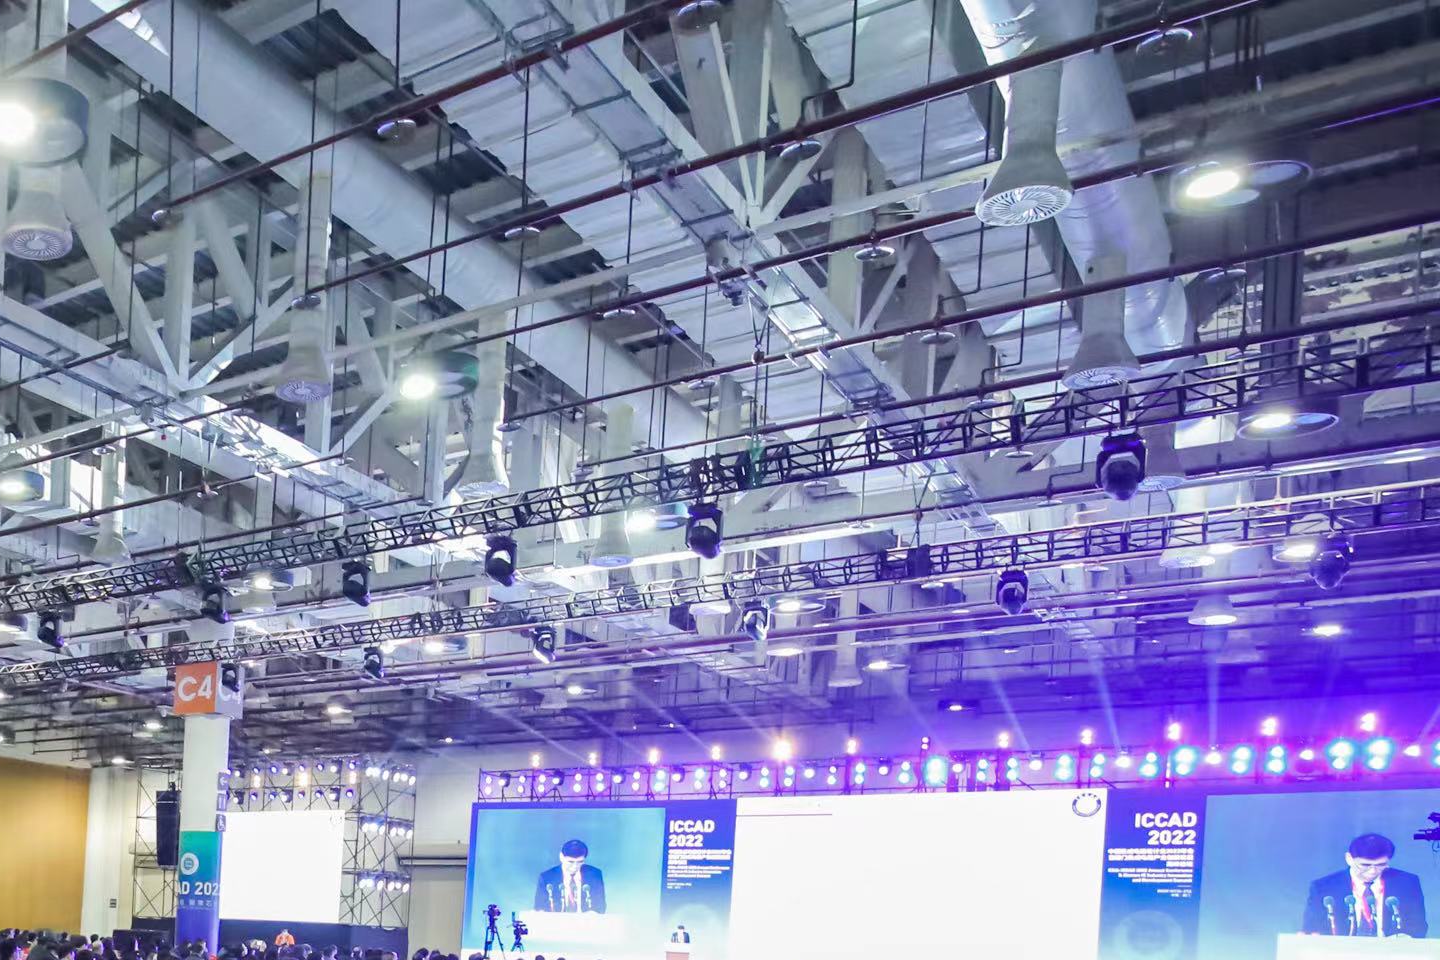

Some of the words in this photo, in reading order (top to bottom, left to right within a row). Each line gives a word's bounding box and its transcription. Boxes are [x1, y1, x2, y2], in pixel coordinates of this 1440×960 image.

[178, 675, 212, 702] C4
[669, 820, 715, 833] ICCAD
[1135, 811, 1197, 828] ICCAD
[668, 834, 704, 847] 2022
[1147, 829, 1197, 845] 2022
